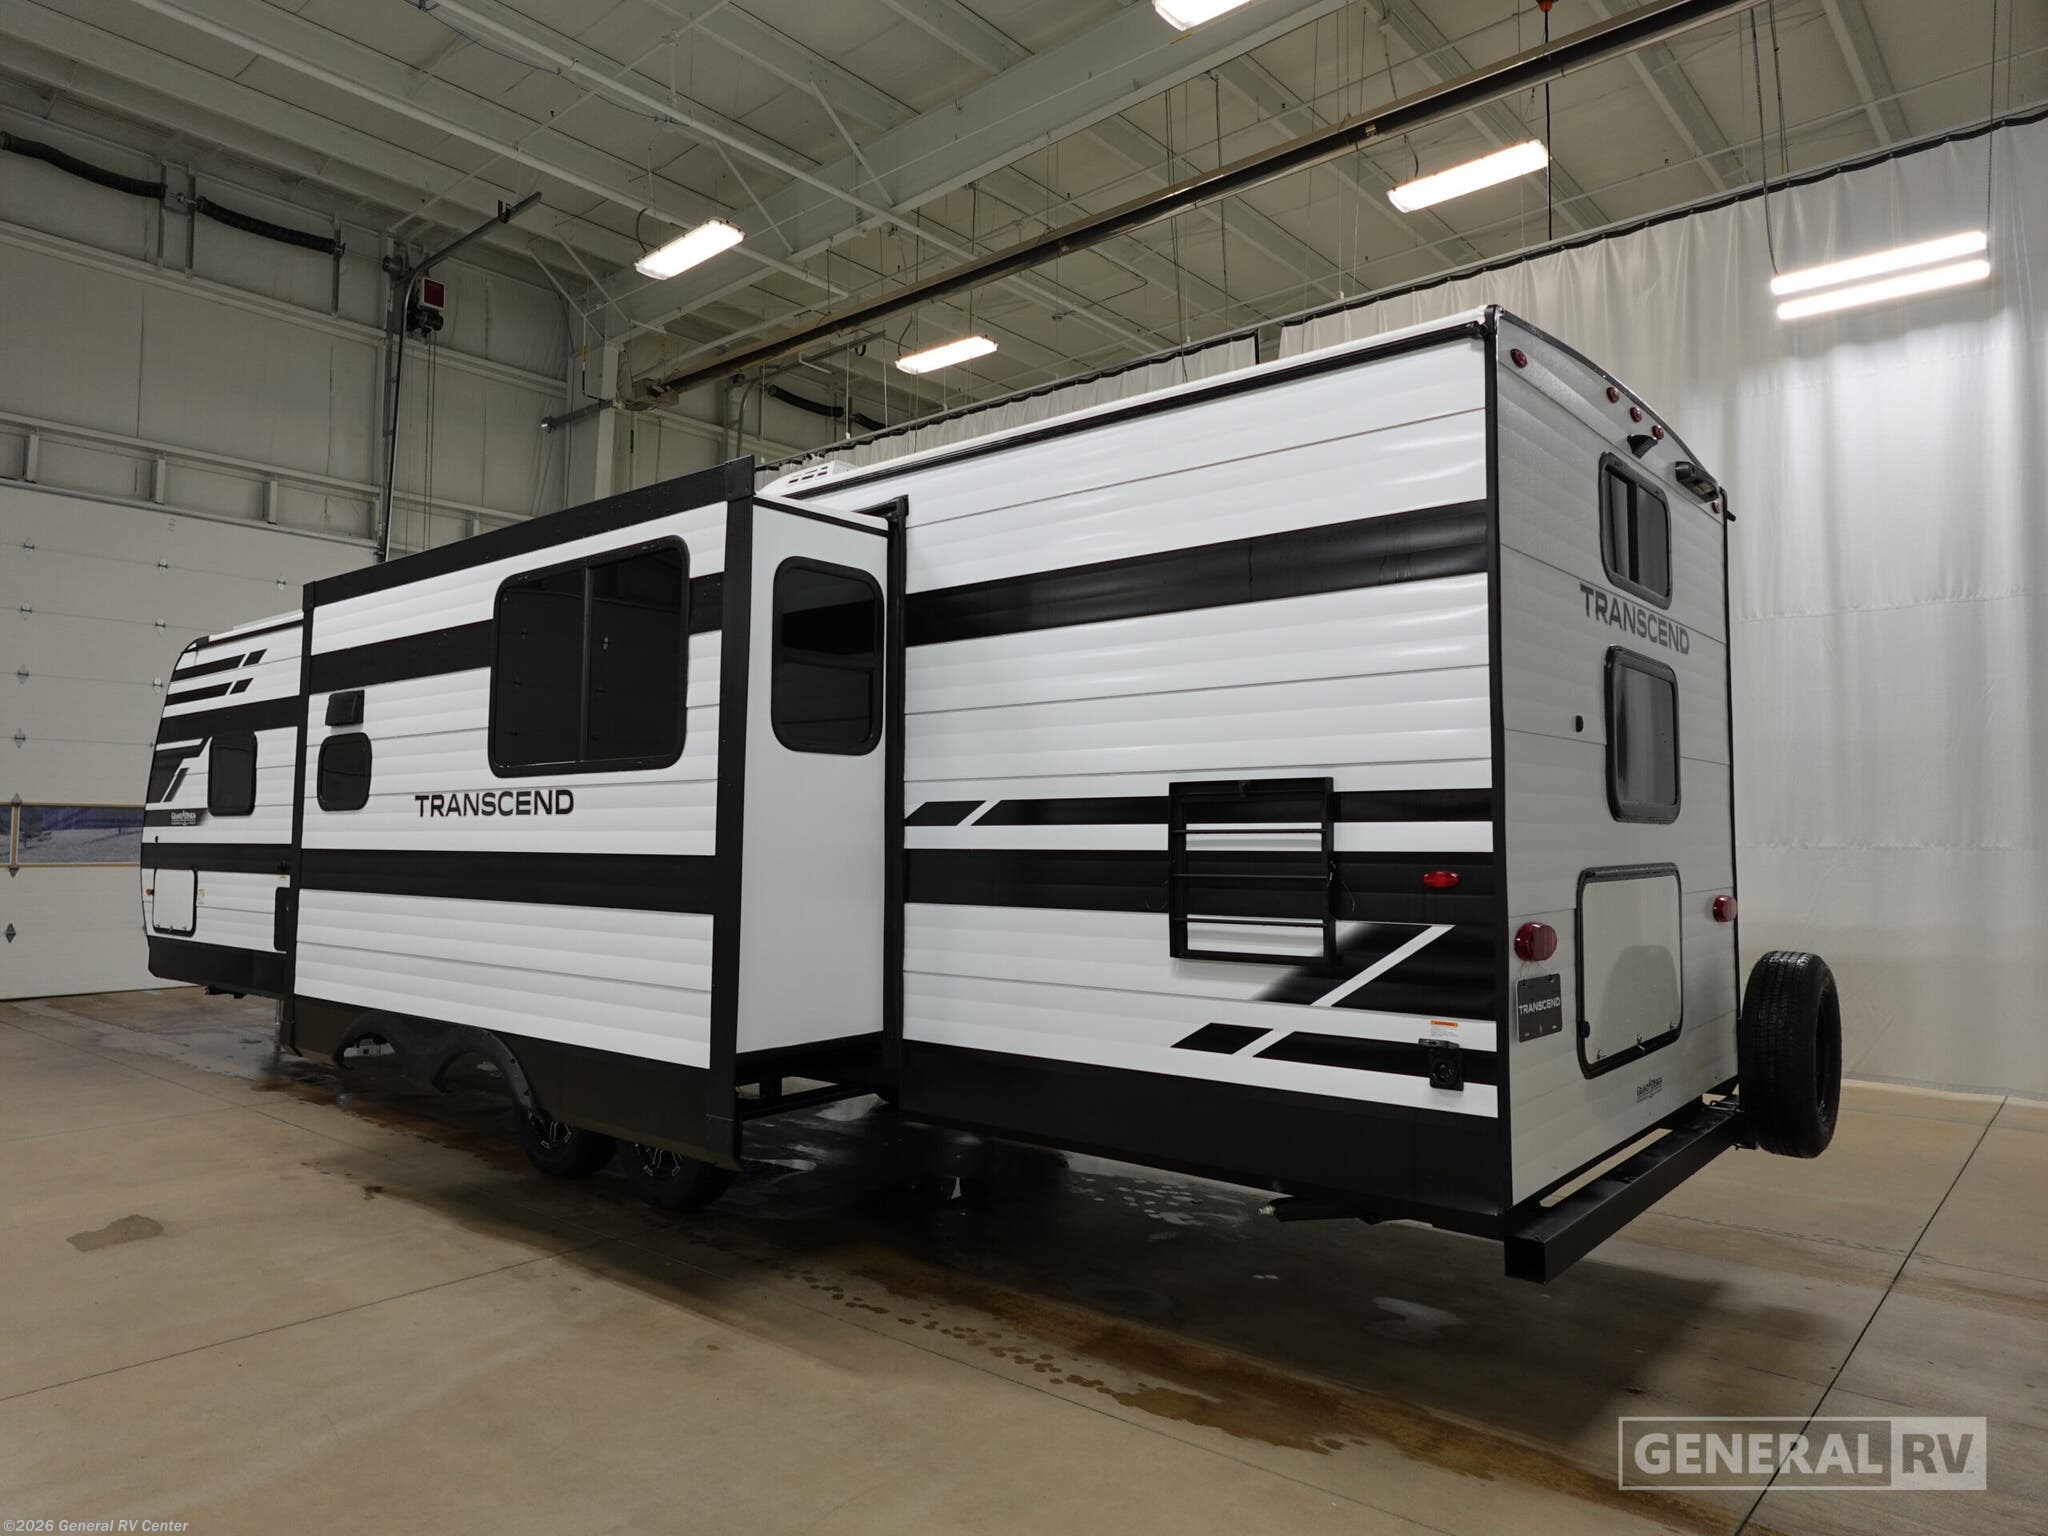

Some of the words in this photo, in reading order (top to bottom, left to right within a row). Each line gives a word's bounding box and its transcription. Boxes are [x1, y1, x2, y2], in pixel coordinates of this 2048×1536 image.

[1580, 583, 1689, 654] TRANSCEND
[415, 789, 574, 817] TRANSCEND
[1519, 997, 1560, 1015] TRANSCEND
